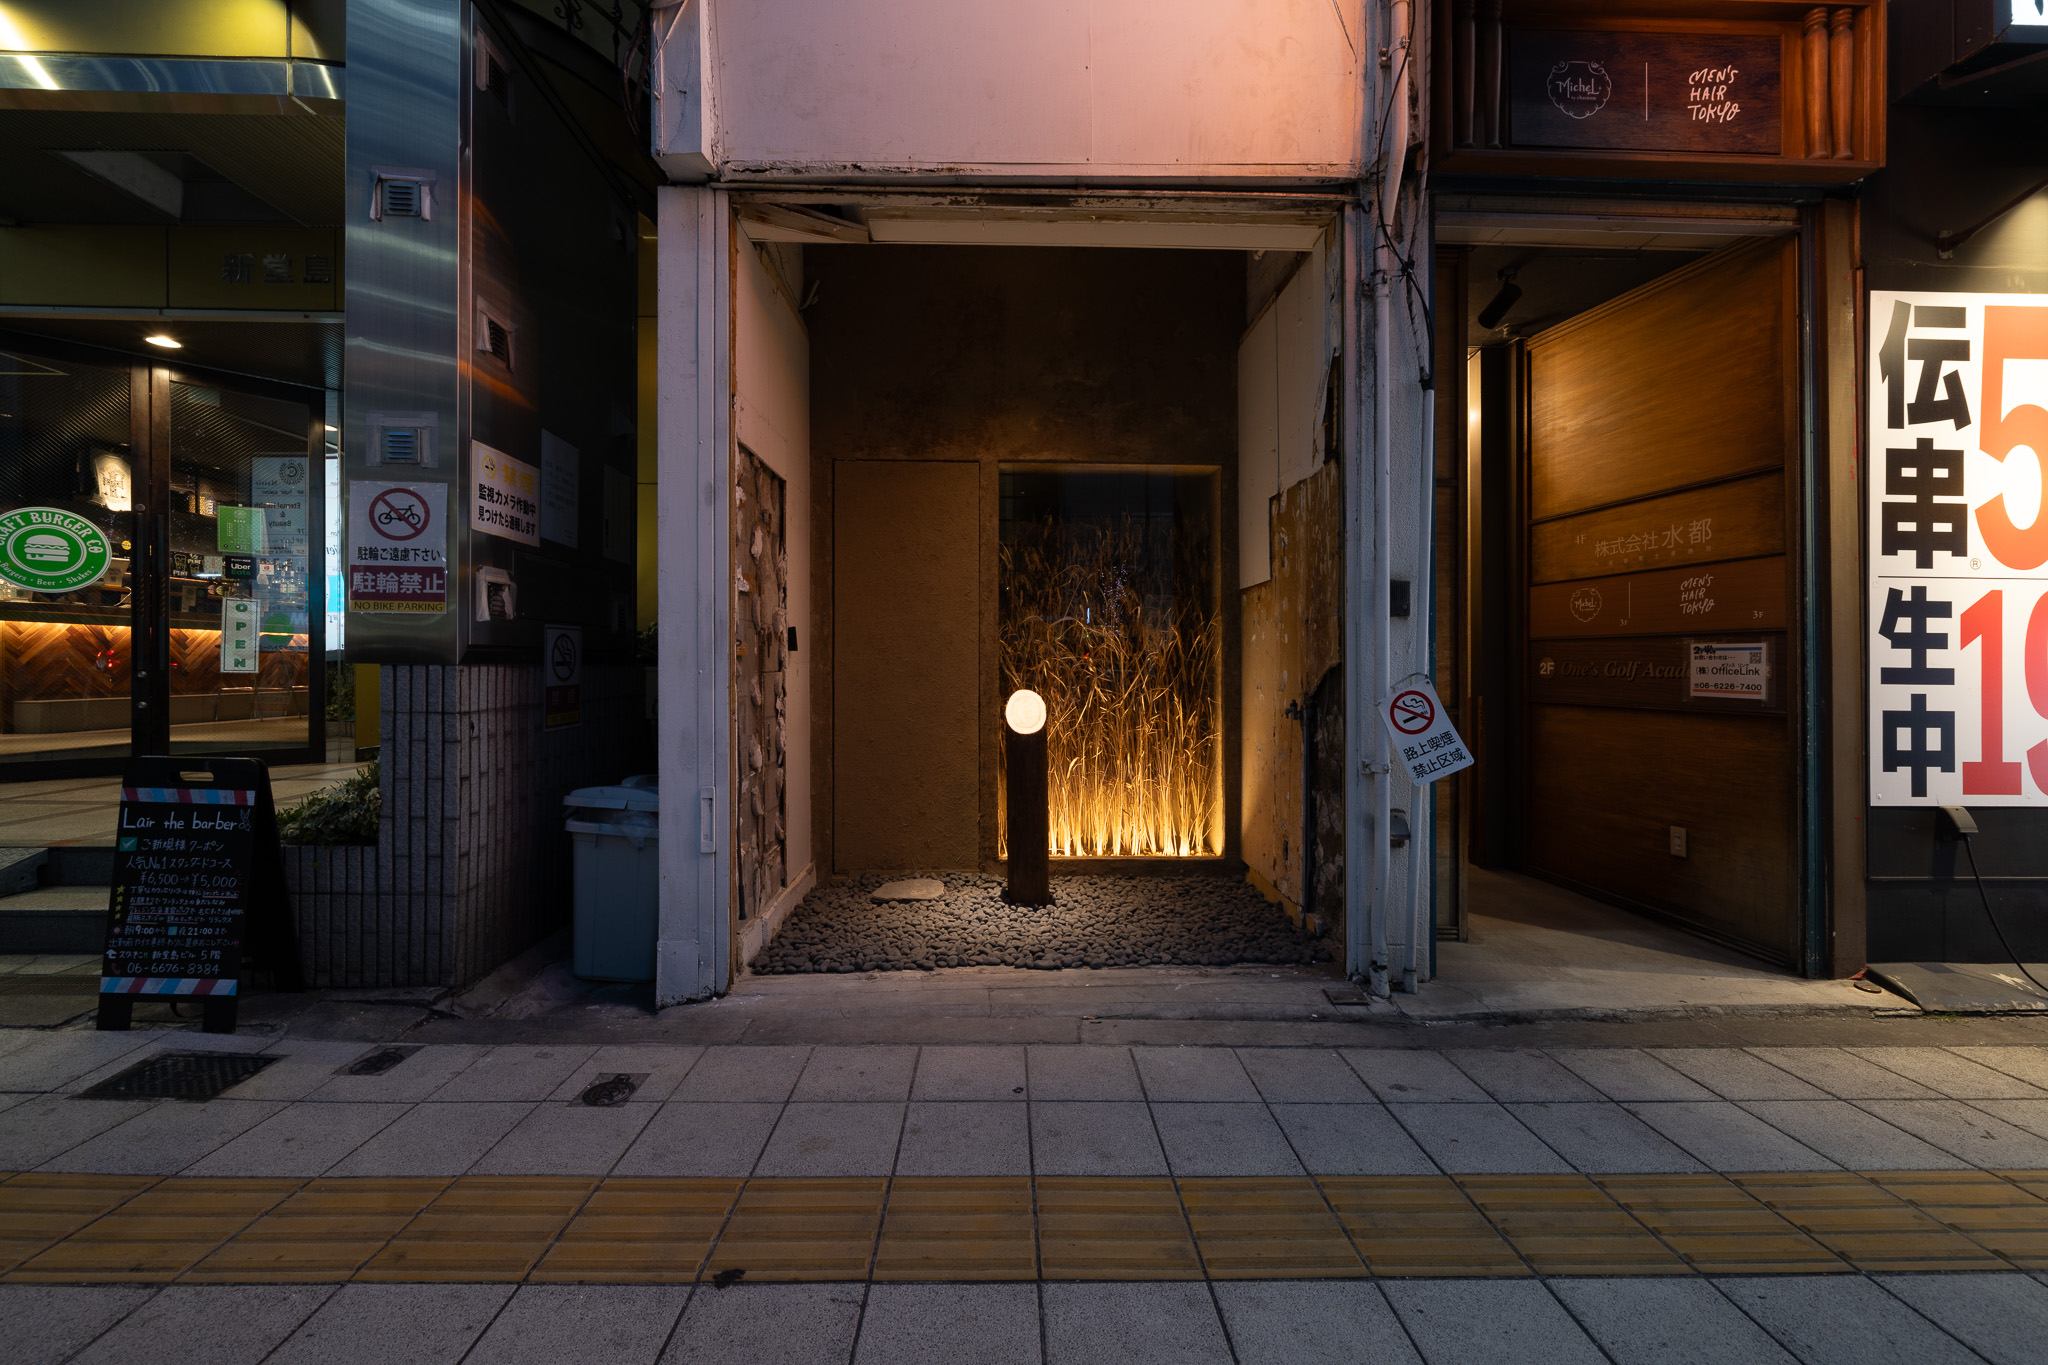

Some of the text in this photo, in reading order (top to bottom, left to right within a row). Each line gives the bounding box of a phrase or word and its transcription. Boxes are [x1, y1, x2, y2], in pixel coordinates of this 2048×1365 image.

[1688, 64, 1739, 85] MEN'S
[1690, 84, 1728, 102] HAIR
[1687, 101, 1741, 124] TOKYO
[222, 252, 331, 284] 新堂島
[1878, 299, 1972, 570] 伝串
[502, 463, 534, 496] 禁煙
[478, 483, 536, 518] 監視カメラ作動中
[30, 511, 93, 538] BURGER
[478, 505, 536, 536] 見つけたら通報します
[357, 546, 441, 562] 駐輪ご遠慮下さい
[0, 562, 93, 587] Burgers Beer Shakes
[230, 563, 252, 571] Uber
[352, 571, 445, 594] 駐輪禁止
[1680, 573, 1714, 591] MEN'S
[1680, 587, 1706, 601] HAIR
[354, 601, 443, 613] NO BIKE PARKING
[1680, 598, 1716, 615] TOKYO
[234, 603, 249, 668] OPEN
[1539, 660, 1690, 682] 2F One's Golf Acad
[1711, 666, 1761, 677] OfficeLink
[1878, 585, 1956, 798] 生中
[1402, 730, 1457, 762] 路上喫煙
[1411, 747, 1467, 779] 禁止区域
[122, 807, 238, 831] Lair the barber
[127, 962, 221, 976] 06-6676-8384
